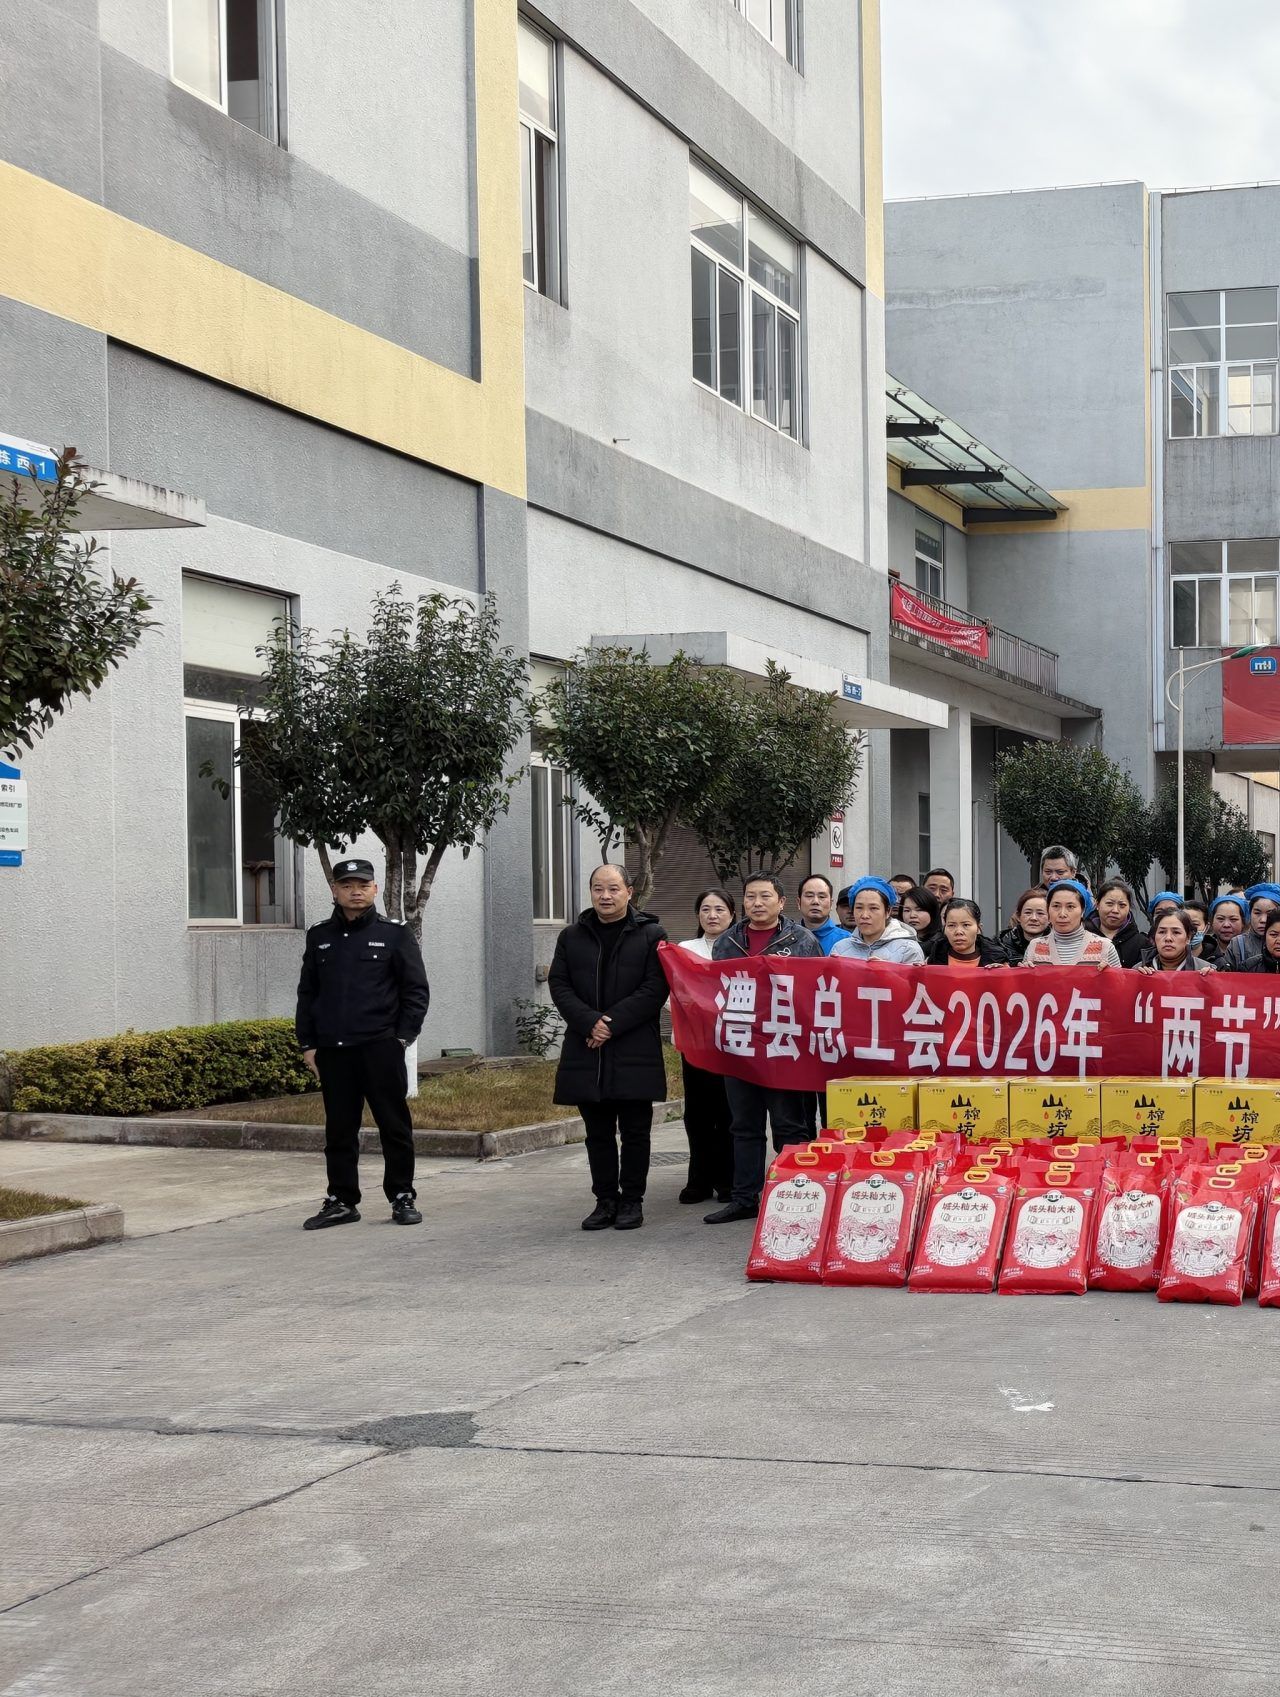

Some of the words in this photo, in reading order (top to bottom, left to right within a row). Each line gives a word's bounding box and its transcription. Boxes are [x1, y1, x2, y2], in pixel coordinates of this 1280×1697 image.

[714, 970, 1103, 1078] 澧县总工会2026年
